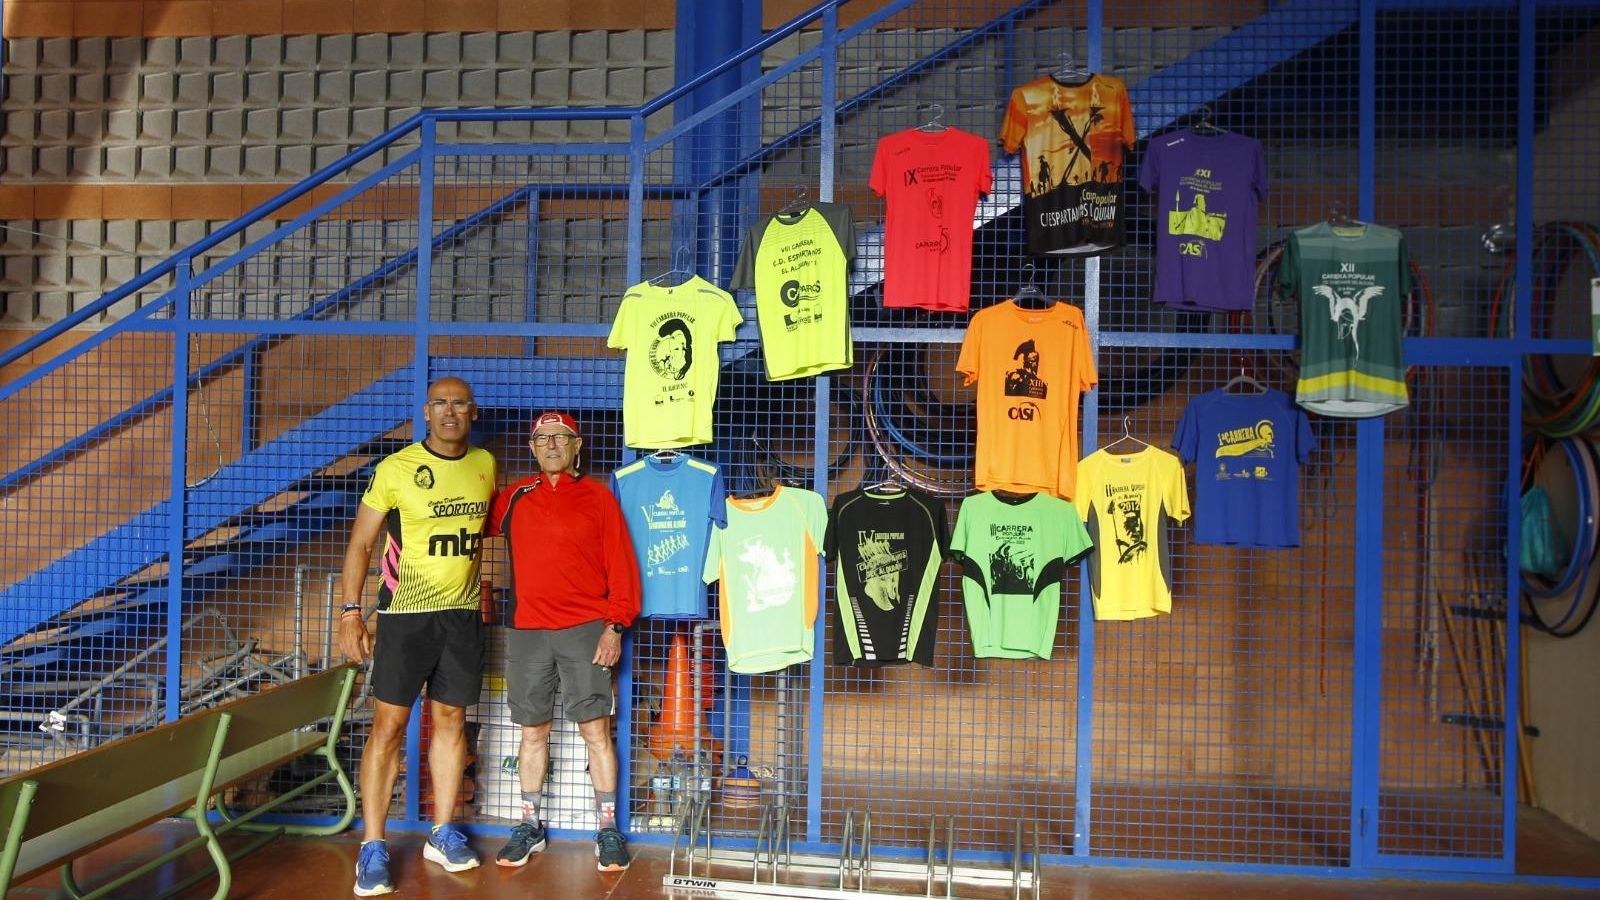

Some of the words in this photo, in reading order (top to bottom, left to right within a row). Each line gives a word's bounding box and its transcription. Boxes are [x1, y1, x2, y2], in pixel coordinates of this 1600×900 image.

[904, 168, 918, 187] IX
[1340, 263, 1355, 273] XII
[1348, 273, 1375, 281] POPULAR
[1224, 426, 1256, 444] CARRERA
[1120, 501, 1140, 512] 2012
[996, 525, 1034, 533] CARRERA
[857, 530, 876, 546] IV
[673, 878, 717, 888] B'TWIN
